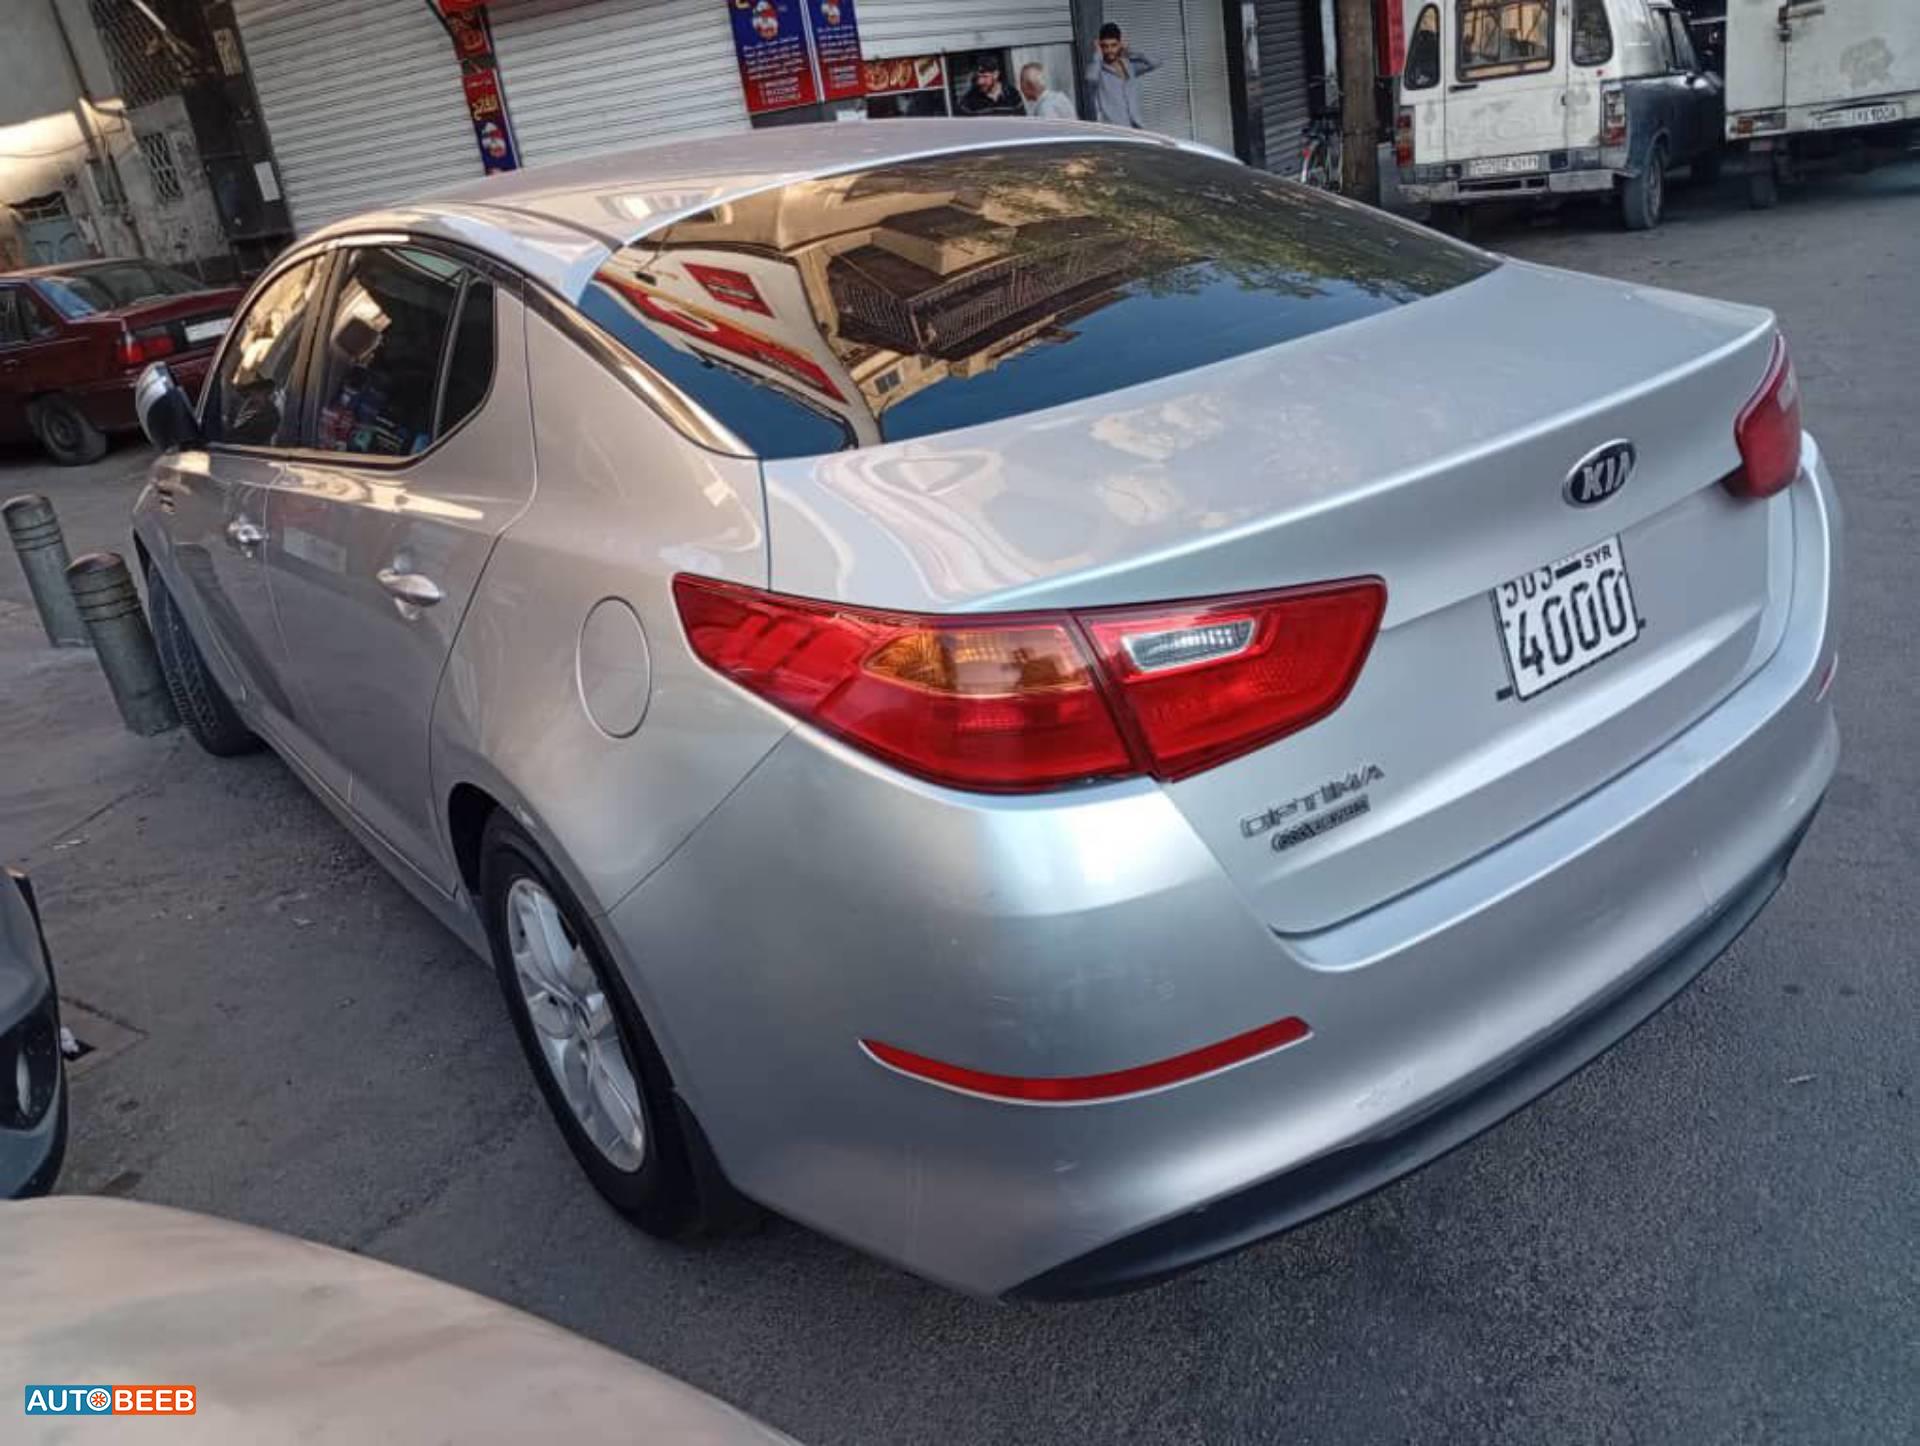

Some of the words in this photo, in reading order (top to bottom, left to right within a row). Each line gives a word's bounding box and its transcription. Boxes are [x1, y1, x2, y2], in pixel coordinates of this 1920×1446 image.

[1581, 451, 1630, 501] KIA
[1584, 544, 1612, 569] SYR
[1518, 568, 1628, 677] 4000
[1240, 764, 1385, 838] OPTIMA
